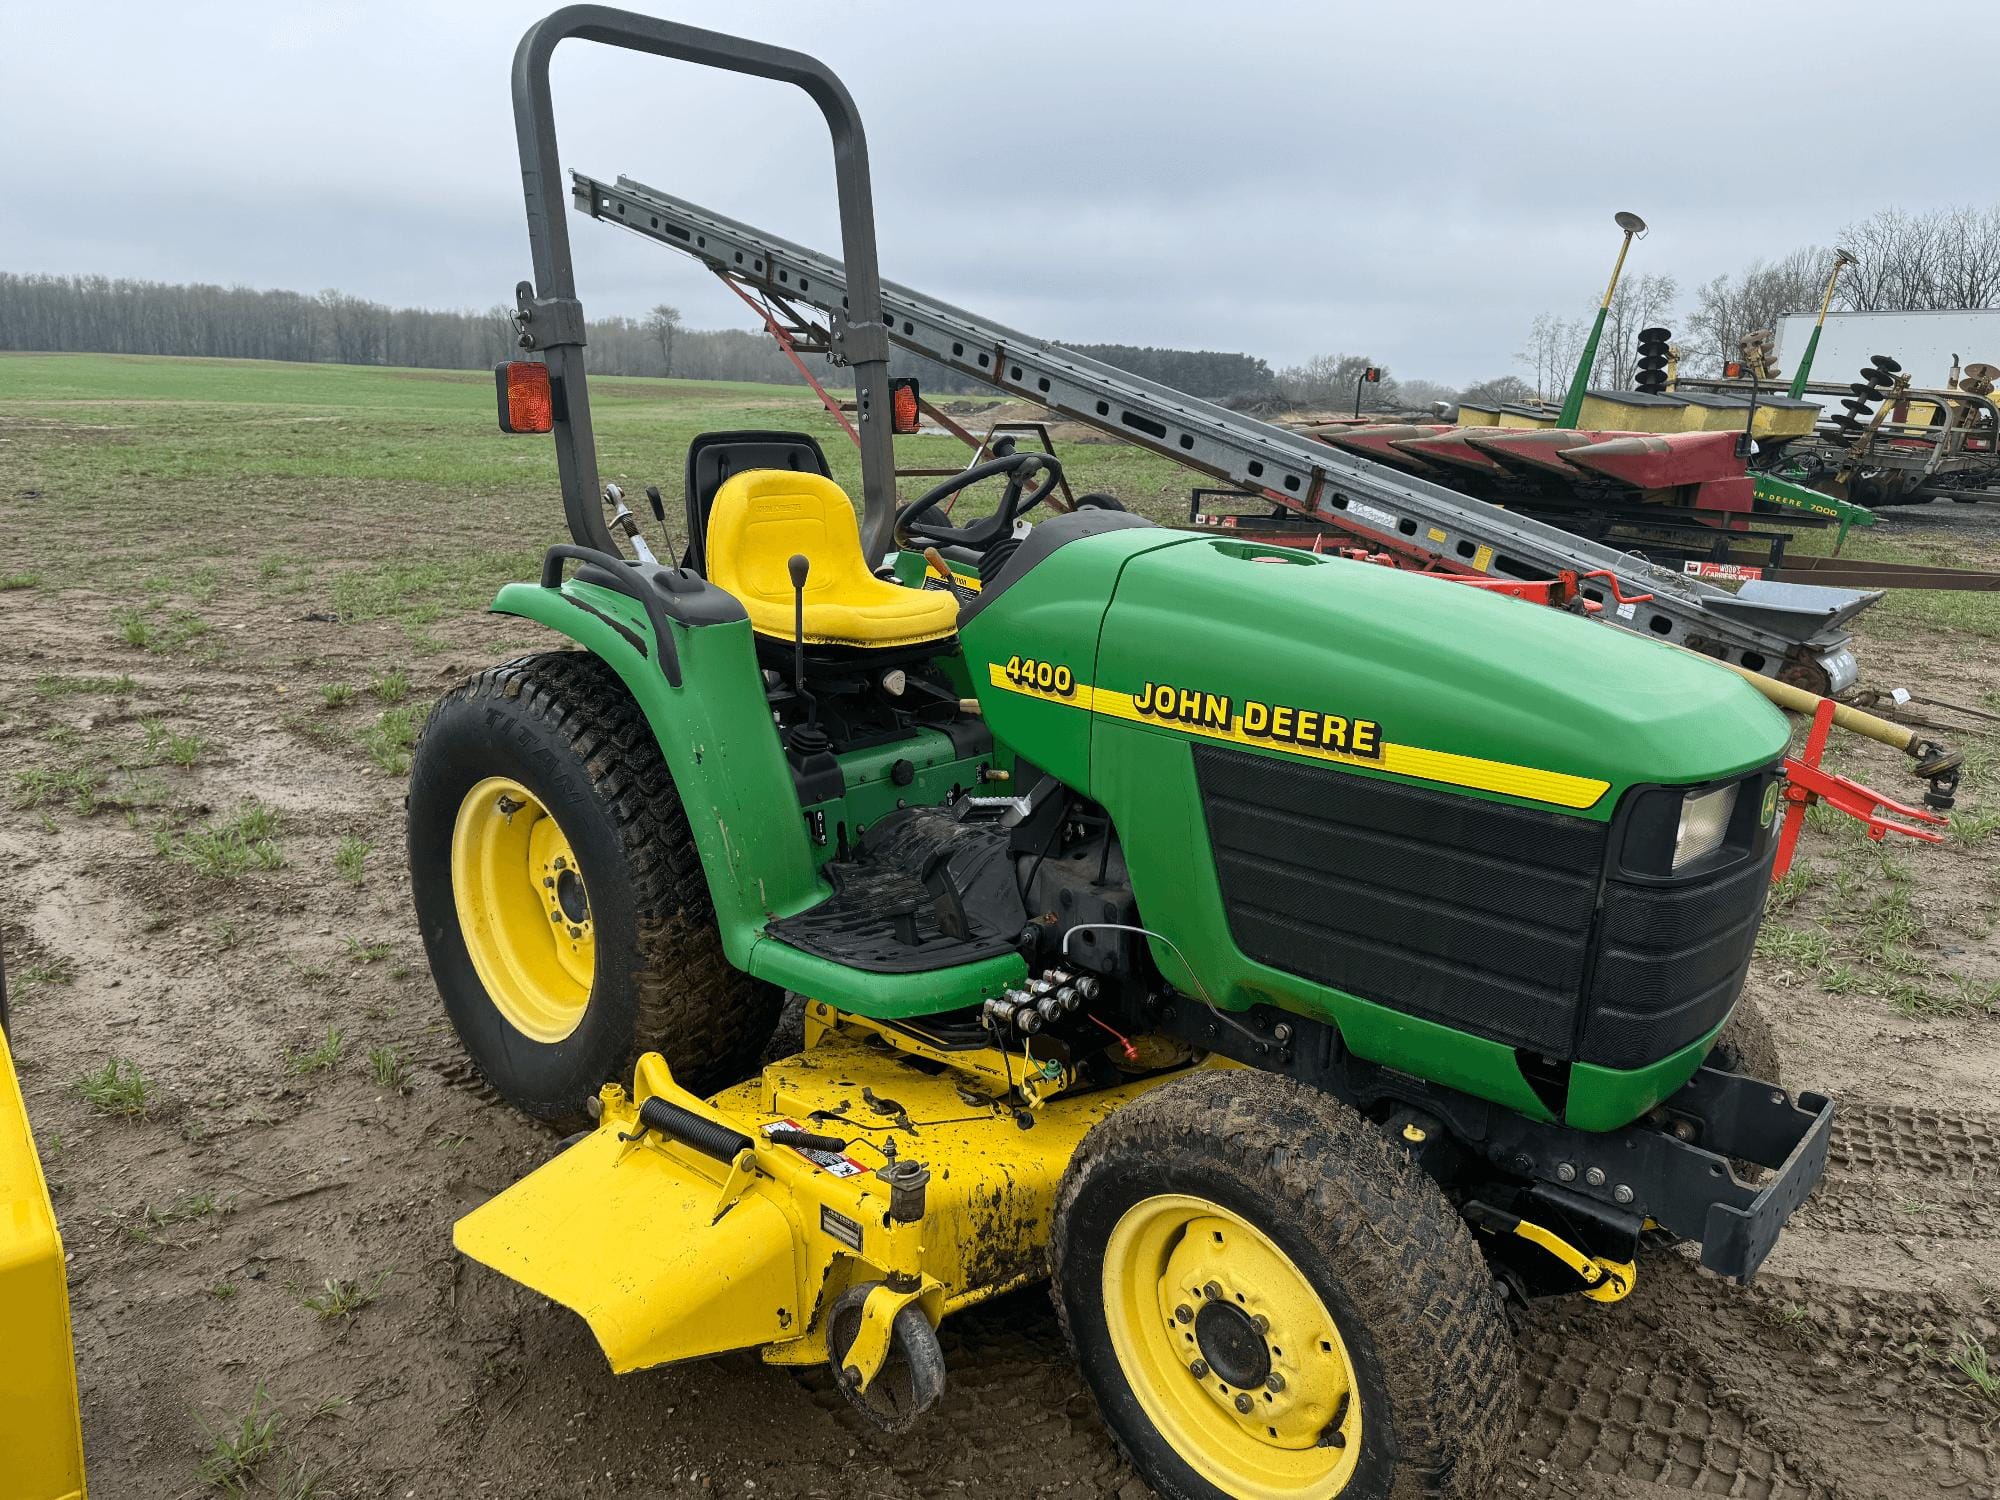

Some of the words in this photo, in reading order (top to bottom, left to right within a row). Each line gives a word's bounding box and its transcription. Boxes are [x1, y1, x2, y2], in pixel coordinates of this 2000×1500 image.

[1769, 495, 1802, 507] DEERE
[1810, 504, 1838, 516] 7000
[1006, 655, 1075, 696] 4400
[1133, 681, 1234, 731] JOHN
[1242, 700, 1383, 760] DEERE
